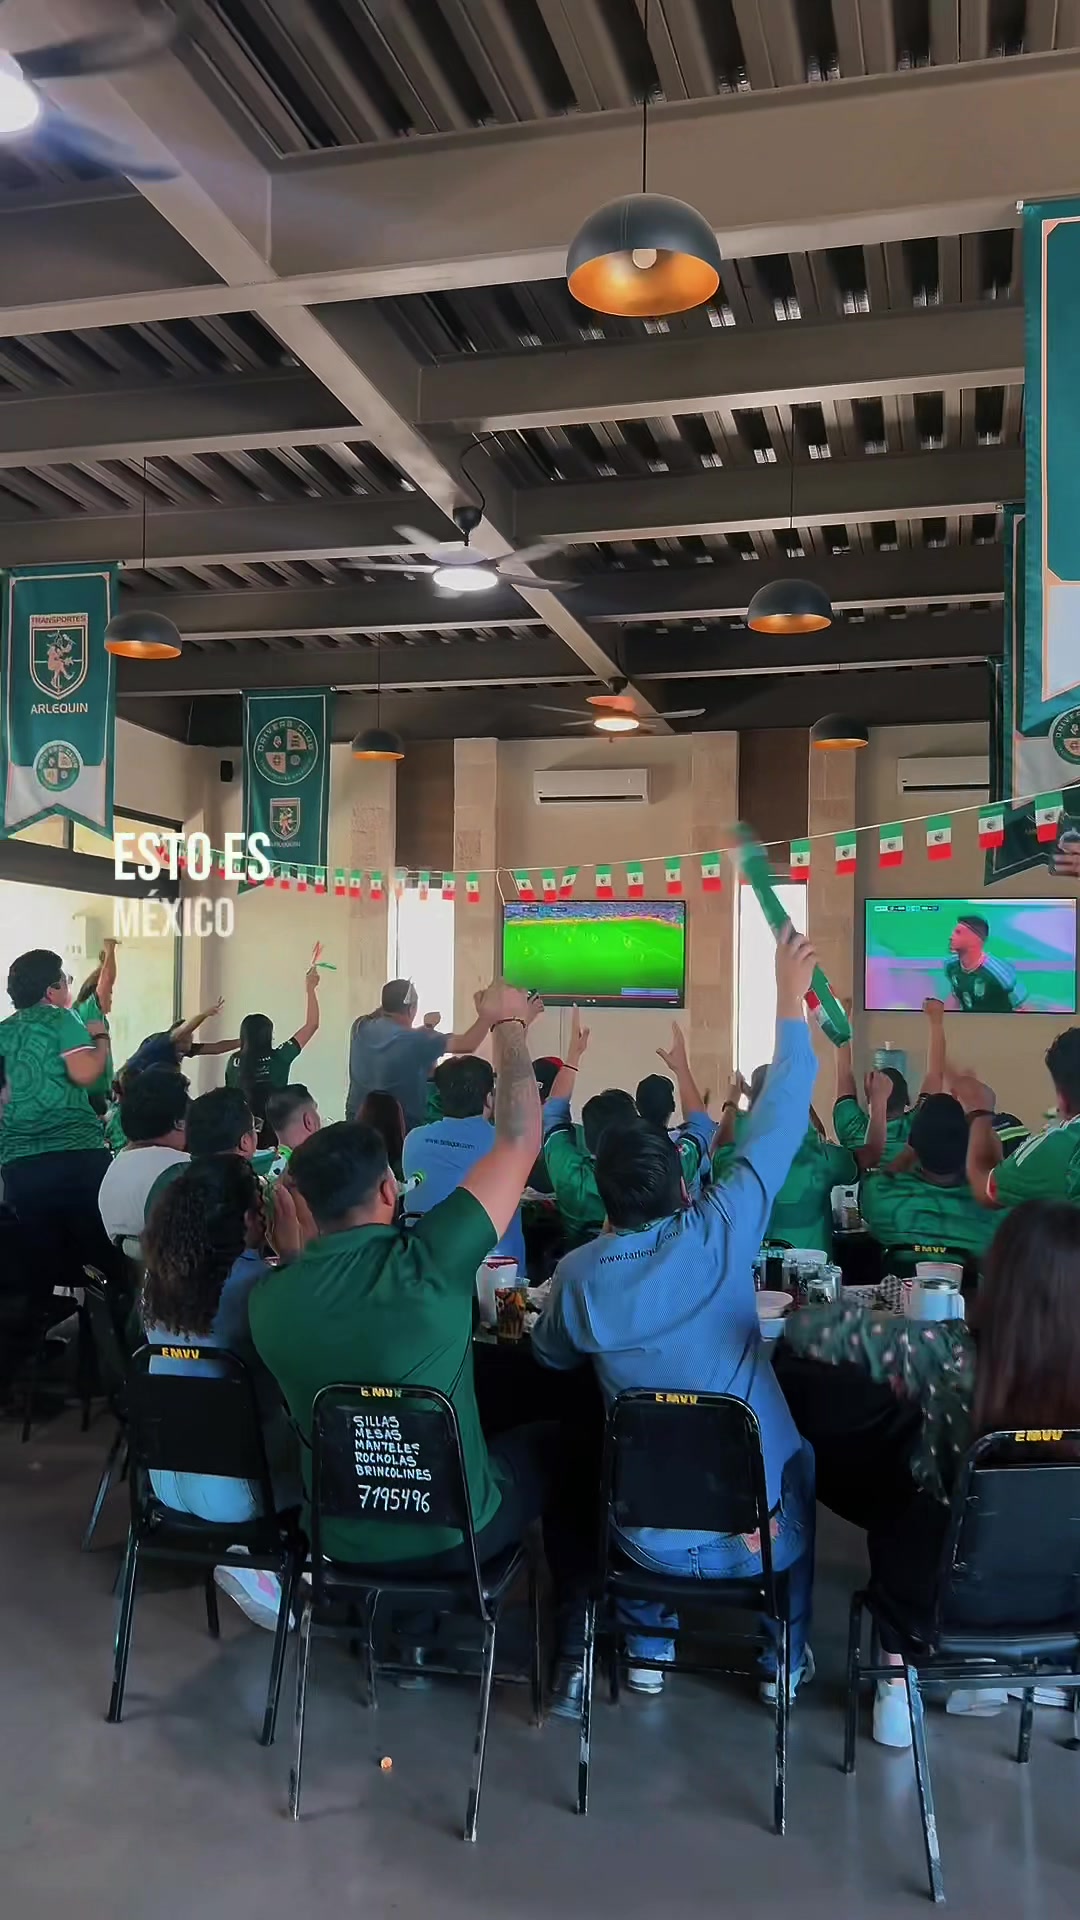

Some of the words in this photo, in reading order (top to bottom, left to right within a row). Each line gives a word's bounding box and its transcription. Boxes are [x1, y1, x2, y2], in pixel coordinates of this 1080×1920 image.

[32, 615, 87, 625] TRANSPORTES
[31, 702, 89, 715] ARLEQUIN
[257, 719, 293, 752] DRIVERS
[297, 724, 315, 751] CLUB
[161, 1346, 200, 1360] EMVV
[353, 1415, 400, 1428] SILLAS
[355, 1428, 402, 1441] MESAS
[354, 1440, 420, 1455] MANTELES
[354, 1451, 417, 1467] ROCKOLAS
[355, 1464, 432, 1481] BRINCOLINES
[357, 1484, 431, 1513] 7195496
